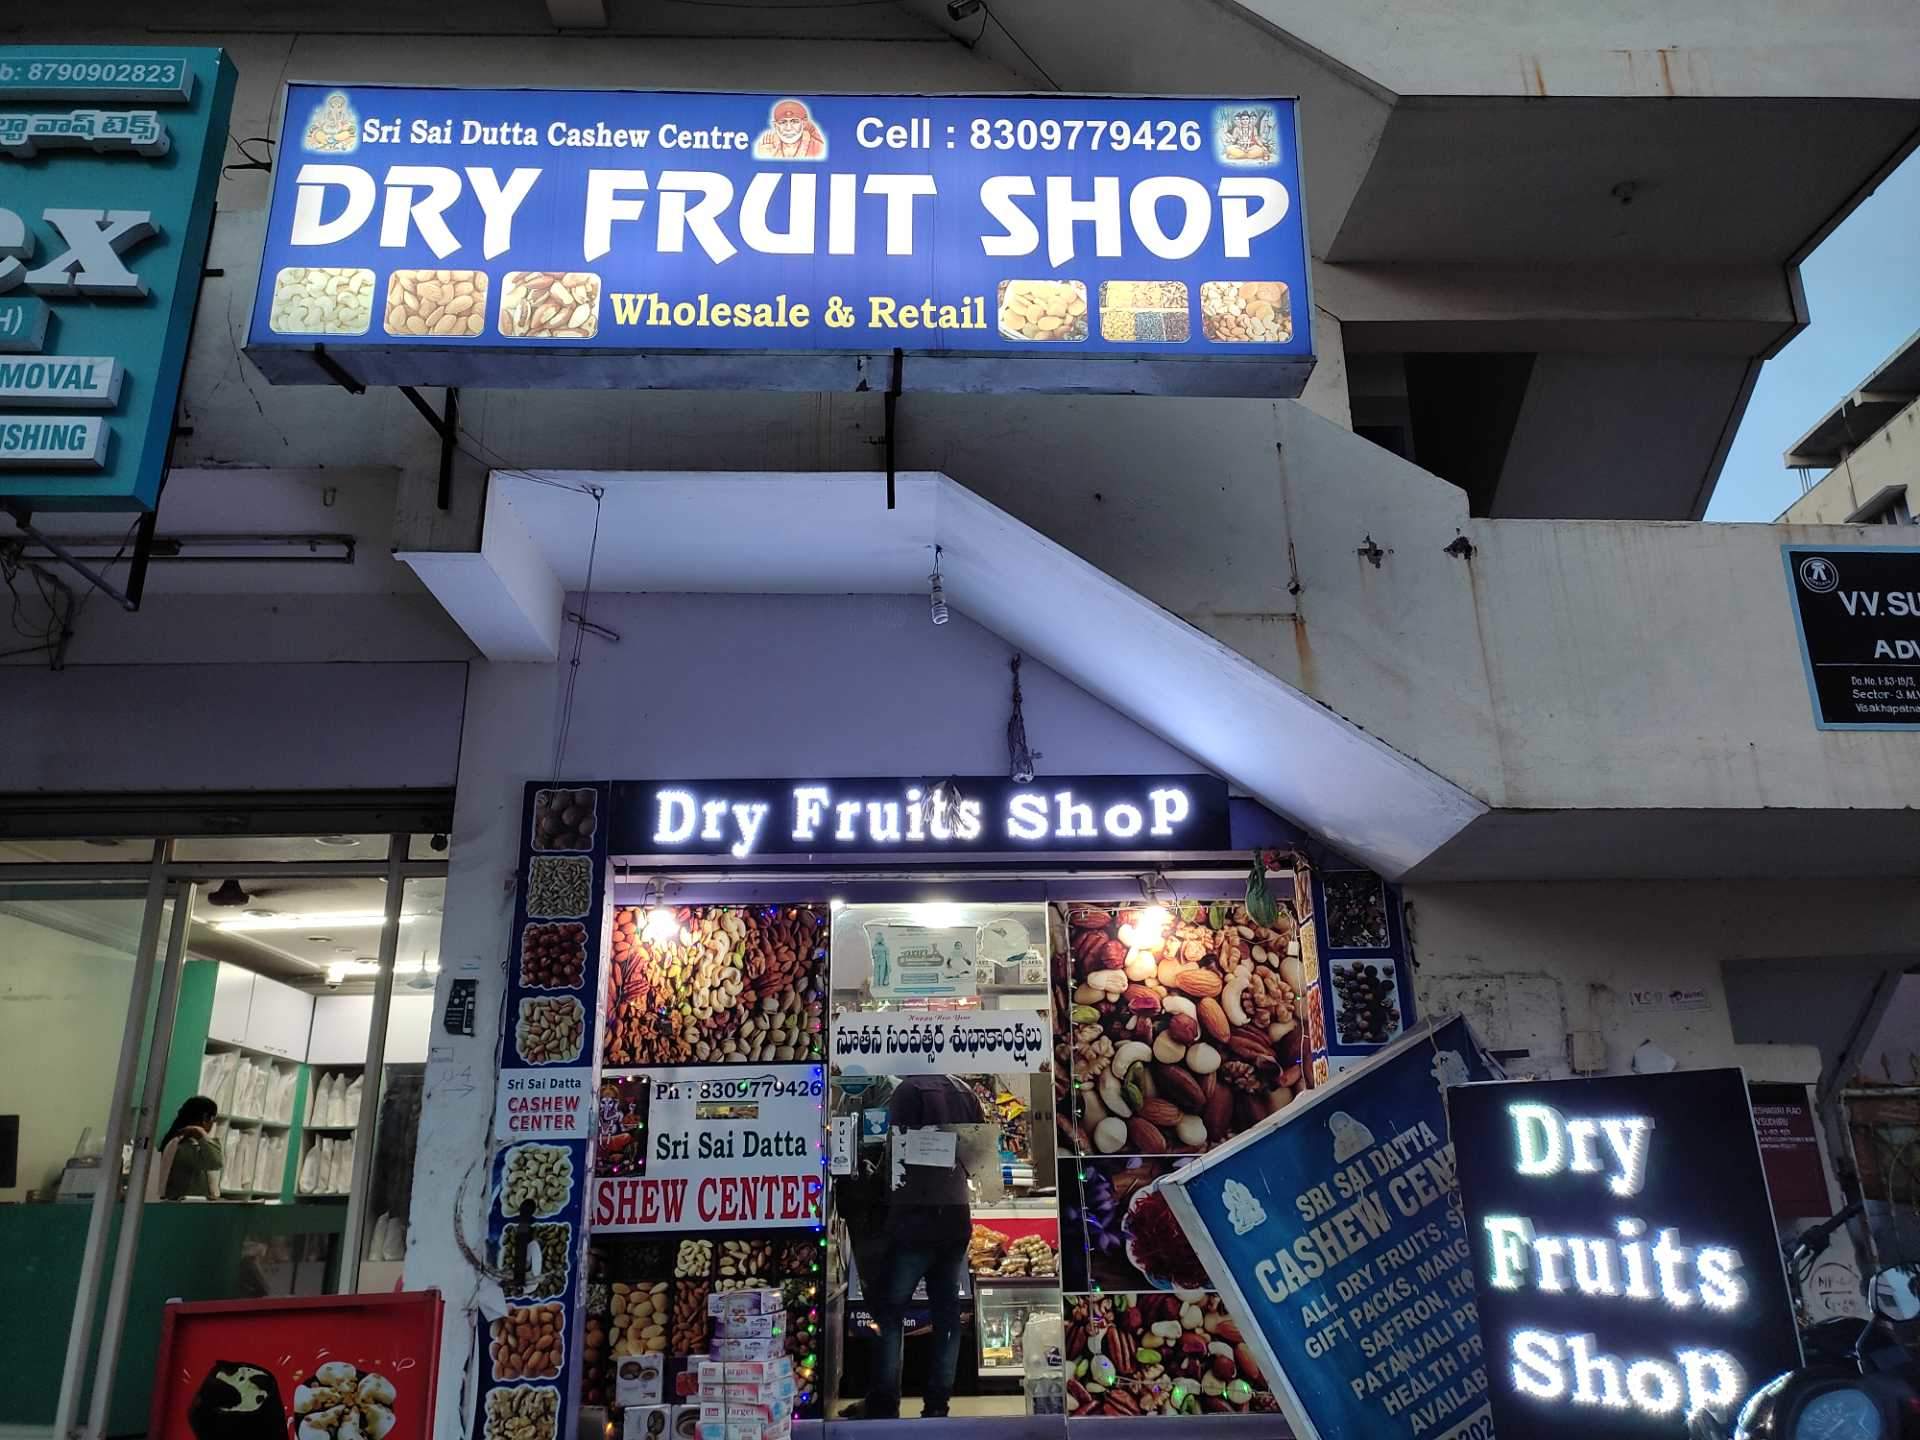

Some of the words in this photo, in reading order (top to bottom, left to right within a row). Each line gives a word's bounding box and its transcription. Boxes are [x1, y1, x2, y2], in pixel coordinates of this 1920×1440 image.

[28, 63, 176, 82] 8790902823
[362, 117, 402, 144] Sri
[410, 119, 453, 146] Sai
[460, 120, 538, 148] Dutta
[547, 122, 650, 149] Cashew
[658, 124, 750, 151] Centre
[856, 116, 931, 150] Cell
[969, 118, 1202, 152] 8309779426
[290, 163, 544, 261] DRY
[583, 168, 939, 265] FRUIT
[979, 175, 1290, 269] SHOP
[610, 292, 810, 329] Wholesale
[824, 296, 856, 329] &
[868, 295, 988, 330] Retail
[653, 788, 767, 858] Dry
[792, 787, 983, 842] Fruits
[1006, 786, 1190, 841] Shop
[507, 1078, 526, 1090] Sri
[528, 1078, 547, 1090] Sai
[549, 1077, 582, 1090] Datta
[507, 1095, 580, 1113] CASHEW
[699, 1080, 823, 1099] 8309779426
[508, 1114, 577, 1131] CENTER
[656, 1132, 690, 1160] Sri
[698, 1131, 734, 1160] Sai
[742, 1130, 808, 1158] Datta
[1508, 1102, 1656, 1196] Dry
[591, 1178, 689, 1226] SHEW
[699, 1174, 823, 1222] CENTER
[1295, 1181, 1336, 1223] SRI
[1334, 1159, 1373, 1199] SAI
[1368, 1120, 1438, 1177] DATTA
[1254, 1191, 1392, 1304] CASHEW
[1484, 1215, 1750, 1312] Fruits
[1301, 1296, 1339, 1328] ALL
[1336, 1264, 1375, 1303] DRY
[1304, 1316, 1350, 1360] GIFT
[1415, 1237, 1471, 1285] MANG
[1350, 1319, 1455, 1401] PATANJALI
[1381, 1351, 1460, 1417] HEALTH
[1511, 1327, 1746, 1427] Shop
[1409, 1364, 1489, 1437] AVAILAB
